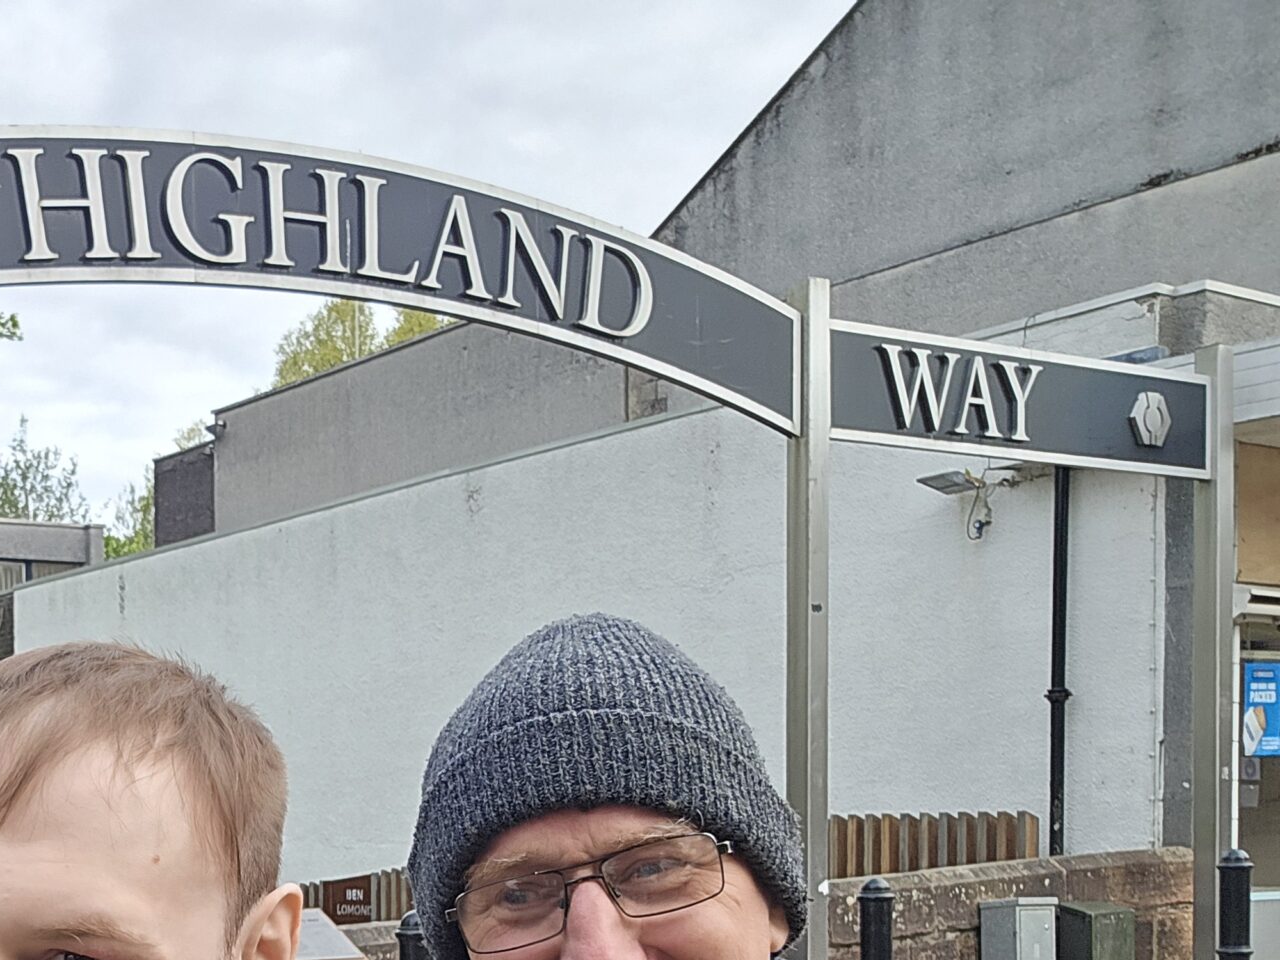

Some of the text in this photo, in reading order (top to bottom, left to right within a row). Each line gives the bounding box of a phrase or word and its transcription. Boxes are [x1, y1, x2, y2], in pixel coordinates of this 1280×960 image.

[6, 147, 654, 338] HIGHLAND
[880, 343, 1044, 442] WAY
[346, 889, 364, 901] BEN
